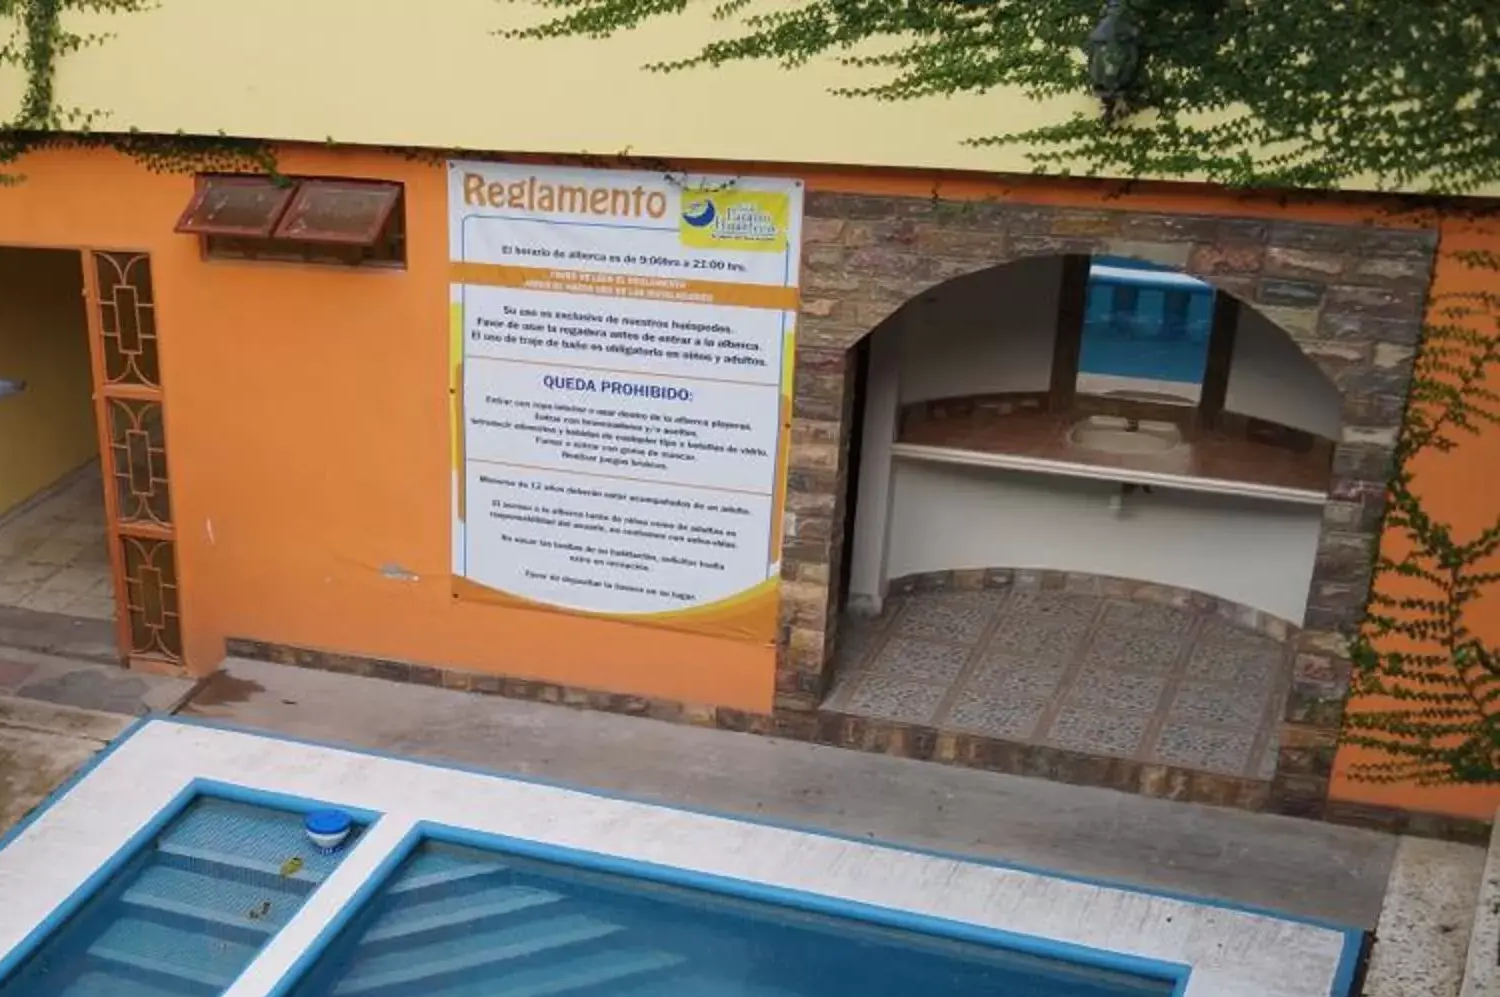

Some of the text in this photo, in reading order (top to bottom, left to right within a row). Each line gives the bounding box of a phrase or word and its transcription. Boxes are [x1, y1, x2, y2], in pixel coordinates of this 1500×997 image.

[463, 172, 667, 218] Reglamento
[501, 244, 512, 255] El
[514, 245, 551, 257] horario
[552, 248, 565, 259] de
[568, 250, 607, 261] alberca
[608, 254, 621, 263] es
[623, 254, 636, 264] de
[682, 259, 690, 268] a
[692, 258, 725, 270] 21:00
[727, 261, 747, 272] hrs.
[503, 305, 516, 315] Su
[519, 308, 537, 317] uso
[540, 310, 552, 318] es
[555, 310, 602, 323] exclusivo
[605, 314, 618, 324] de
[621, 316, 668, 329] nuestros
[477, 316, 504, 328] Favor
[507, 320, 519, 329] de
[547, 323, 556, 333] la
[559, 325, 606, 339] regadera
[609, 329, 639, 341] antes
[641, 332, 655, 342] de
[657, 334, 691, 345] entrar
[694, 337, 701, 346] a
[703, 337, 714, 347] la
[717, 338, 760, 351] alberca.
[471, 329, 481, 340] El
[483, 333, 502, 342] uso
[503, 333, 517, 343] de
[518, 335, 544, 347] traje
[545, 337, 559, 347] de
[561, 339, 588, 350] baño
[589, 343, 603, 352] es
[605, 343, 663, 358] obligatorio
[665, 350, 680, 359] en
[714, 355, 721, 364] y
[723, 353, 768, 367] adultos.
[542, 374, 694, 402] QUEDA PROHIBIDO:
[649, 413, 660, 421] de
[663, 415, 672, 423] la
[531, 480, 541, 490] 12
